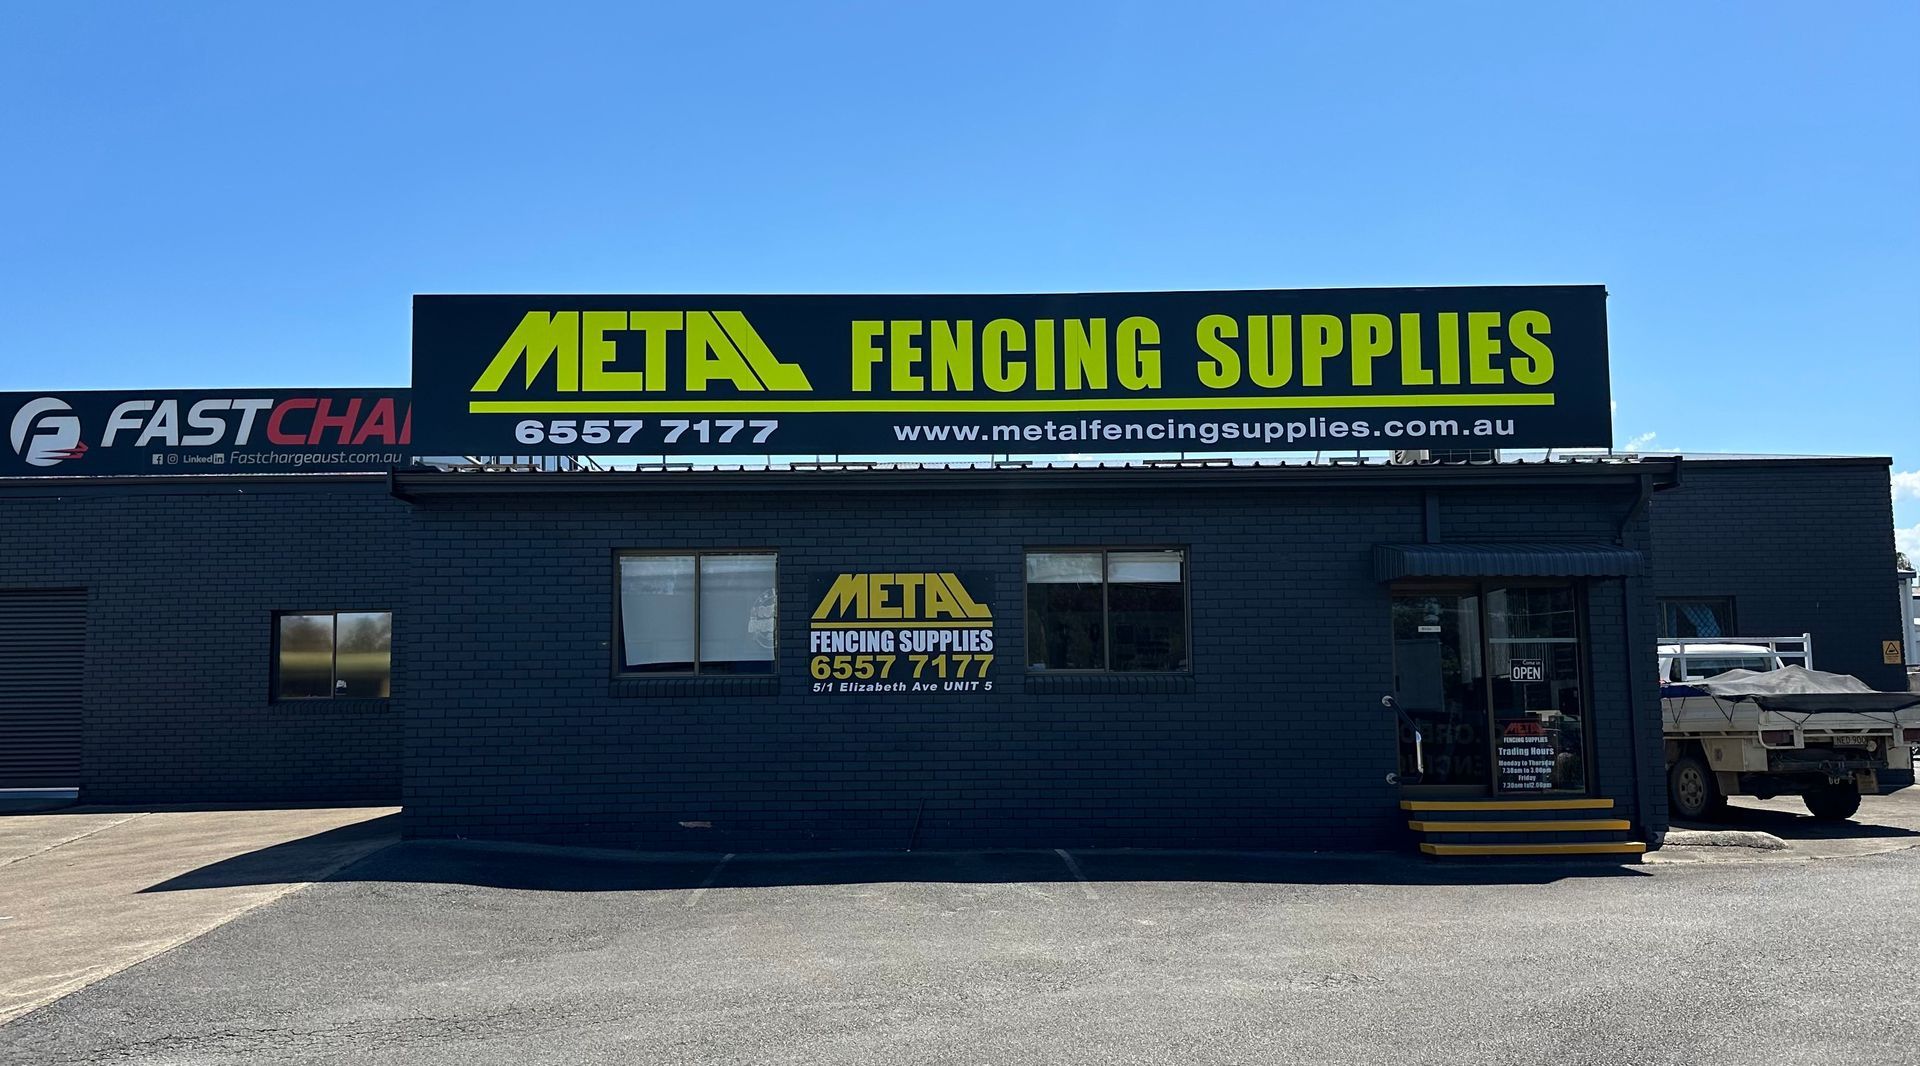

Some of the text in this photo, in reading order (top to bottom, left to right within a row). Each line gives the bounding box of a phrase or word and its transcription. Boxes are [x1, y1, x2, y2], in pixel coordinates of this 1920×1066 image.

[470, 310, 1554, 392] METAL FENCING SUPPLIES
[101, 398, 411, 447] FASTCHA
[515, 418, 1514, 444] 6557 7177 www.metalfencingsupplies.com.au
[230, 451, 402, 467] Fastchargeaust.com.au
[811, 573, 993, 619] METAL
[811, 630, 993, 653] FENCING SUPPLIES
[811, 654, 994, 680] 6557 7177
[1513, 667, 1541, 679] OPEN
[813, 681, 993, 692] 5/1 Elizabeth Ave UNIT 5
[1498, 747, 1555, 756] Trading Hours
[1528, 759, 1555, 767] Thursday
